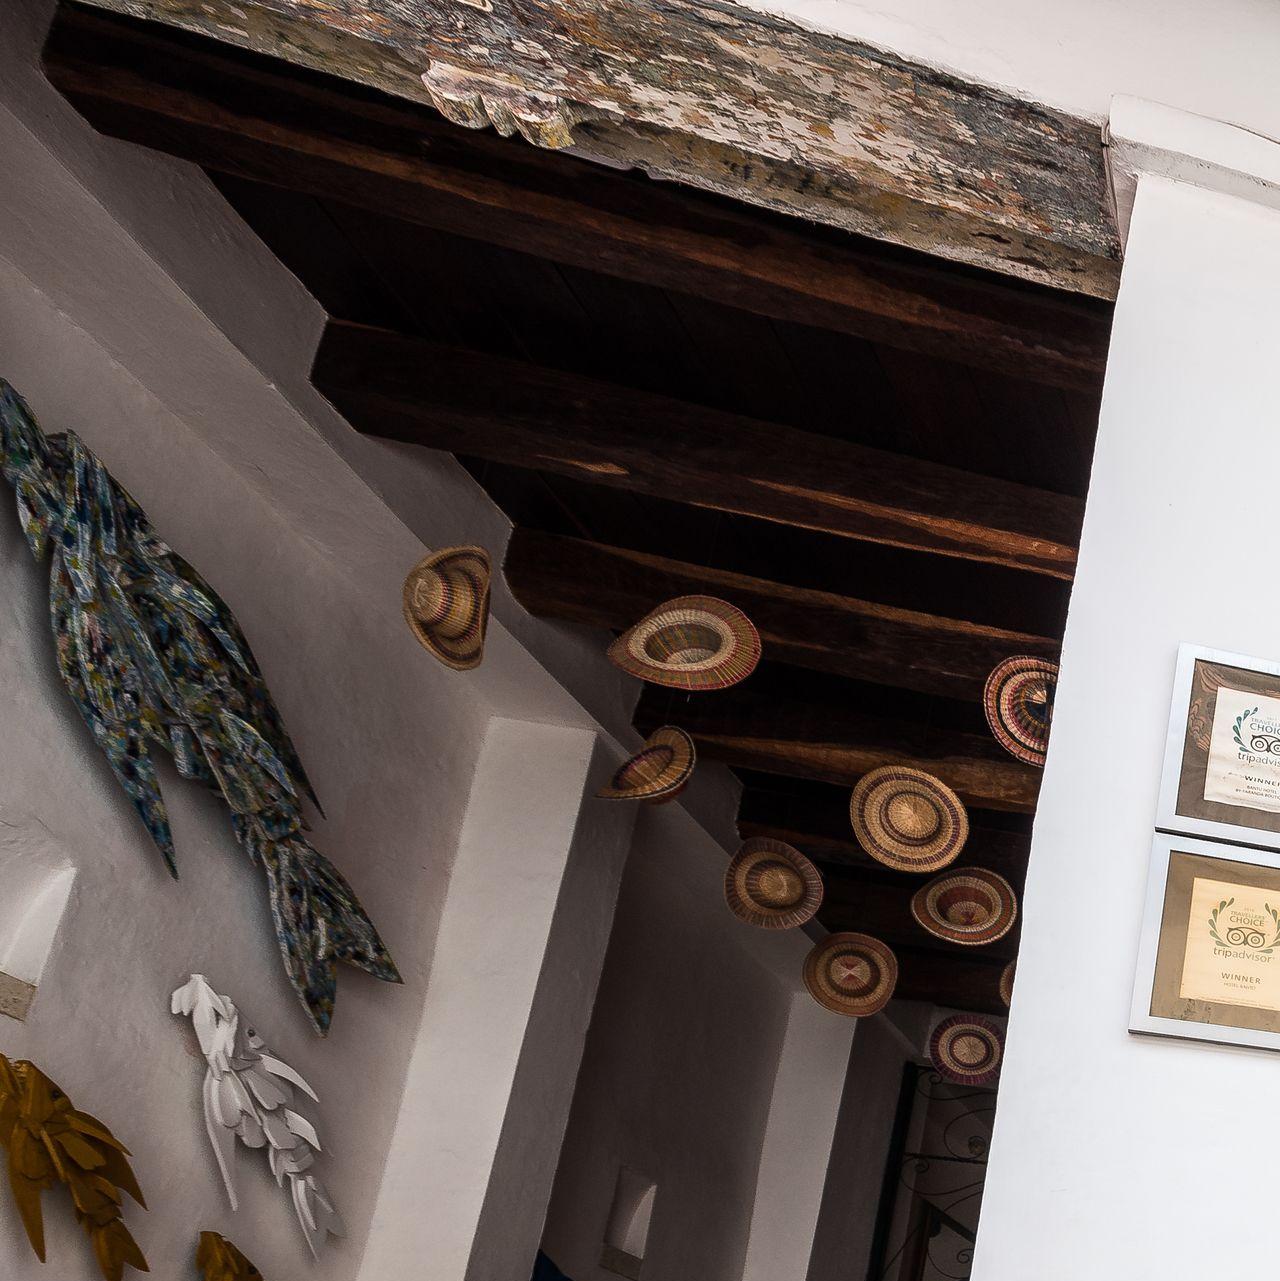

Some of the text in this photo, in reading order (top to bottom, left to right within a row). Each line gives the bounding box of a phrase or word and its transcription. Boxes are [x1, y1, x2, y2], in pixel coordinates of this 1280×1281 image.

[1229, 915, 1265, 927] CHOICE
[1213, 947, 1272, 963] tripadvisor
[1221, 972, 1261, 984] WINNER
